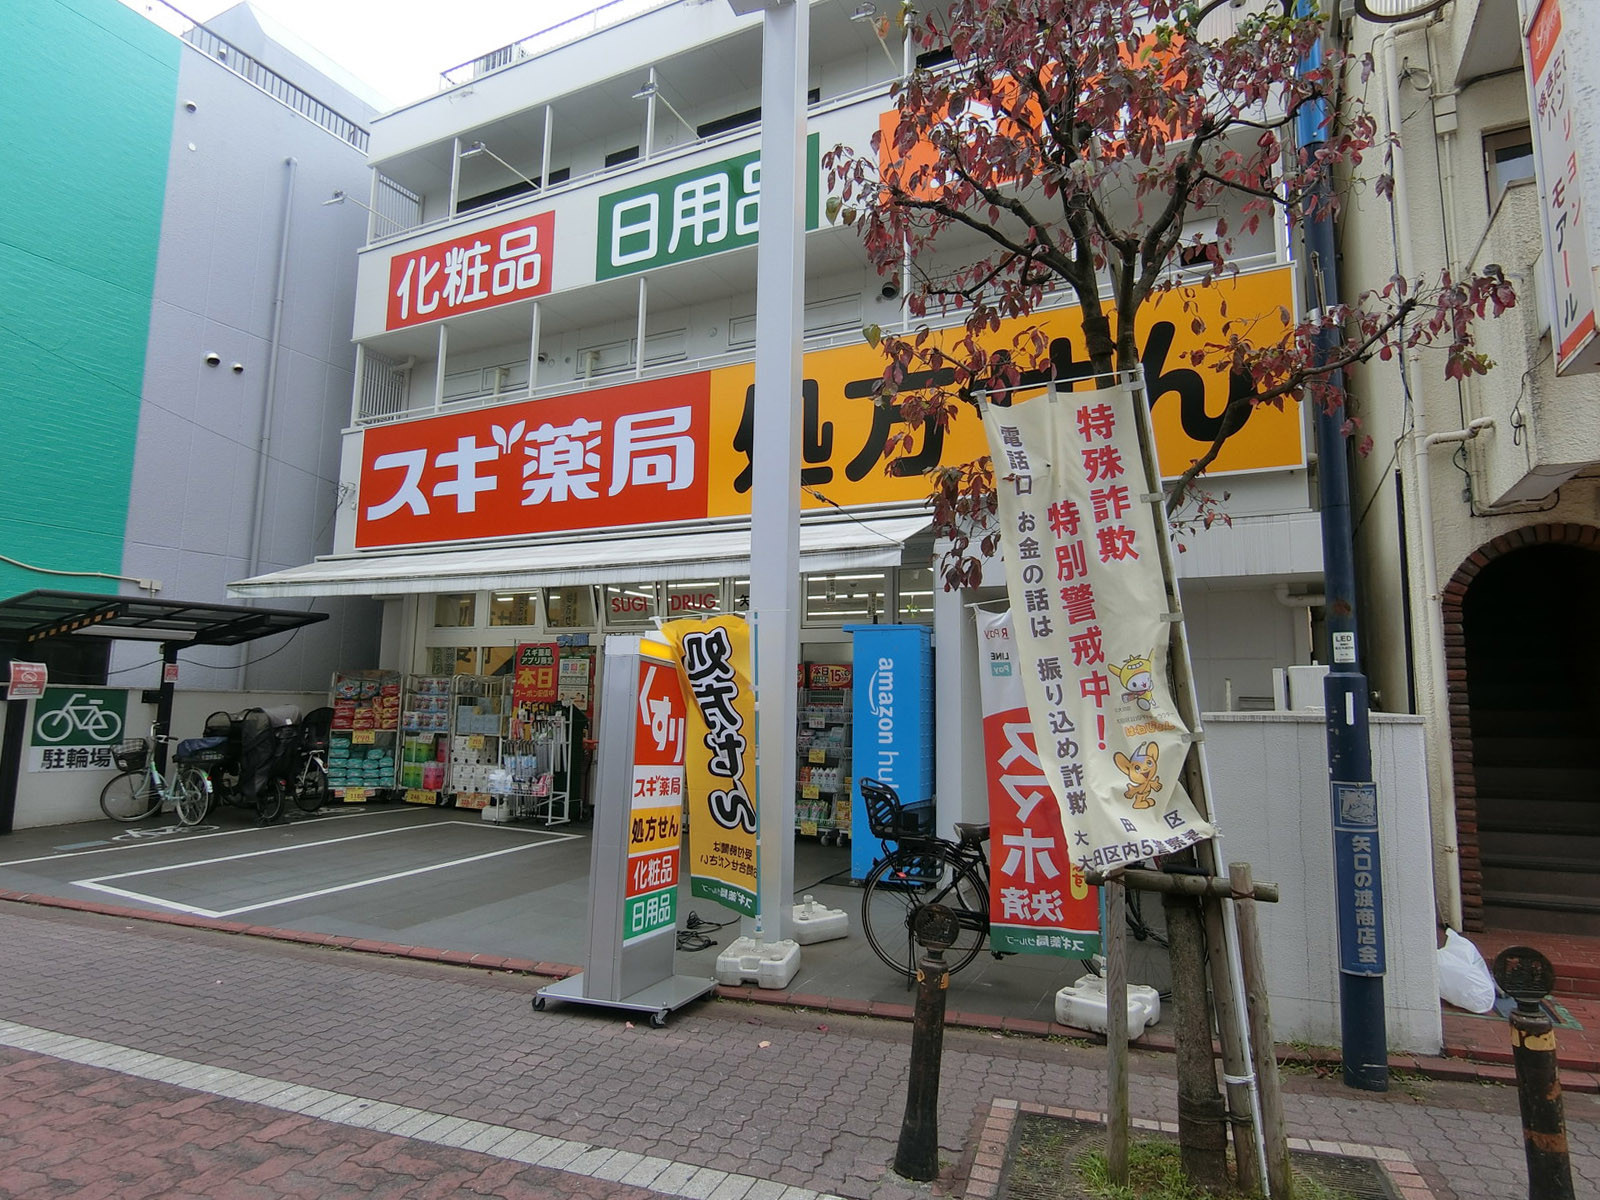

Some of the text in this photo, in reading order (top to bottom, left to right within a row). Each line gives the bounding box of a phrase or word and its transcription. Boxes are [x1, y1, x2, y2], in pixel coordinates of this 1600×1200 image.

[1563, 109, 1581, 227] リヨン
[397, 226, 542, 320] 化粧品
[1552, 176, 1578, 328] モアール
[366, 405, 696, 522] スギ薬局
[1076, 403, 1140, 564] 特殊詐欺
[611, 593, 716, 613] SUGI DRUG
[1000, 426, 1088, 816] 電話口 お金の話は 振り込め詐欺
[518, 667, 553, 688] 本日
[639, 666, 684, 763] くすり
[878, 657, 899, 789] amazon hu
[41, 748, 112, 769] 駐輪場
[634, 775, 681, 798] スギ薬局
[631, 815, 679, 845] 処方せん
[633, 855, 673, 891] 化粧品
[632, 893, 671, 932] 日用品
[1351, 835, 1378, 964] 矢口の渡商店会
